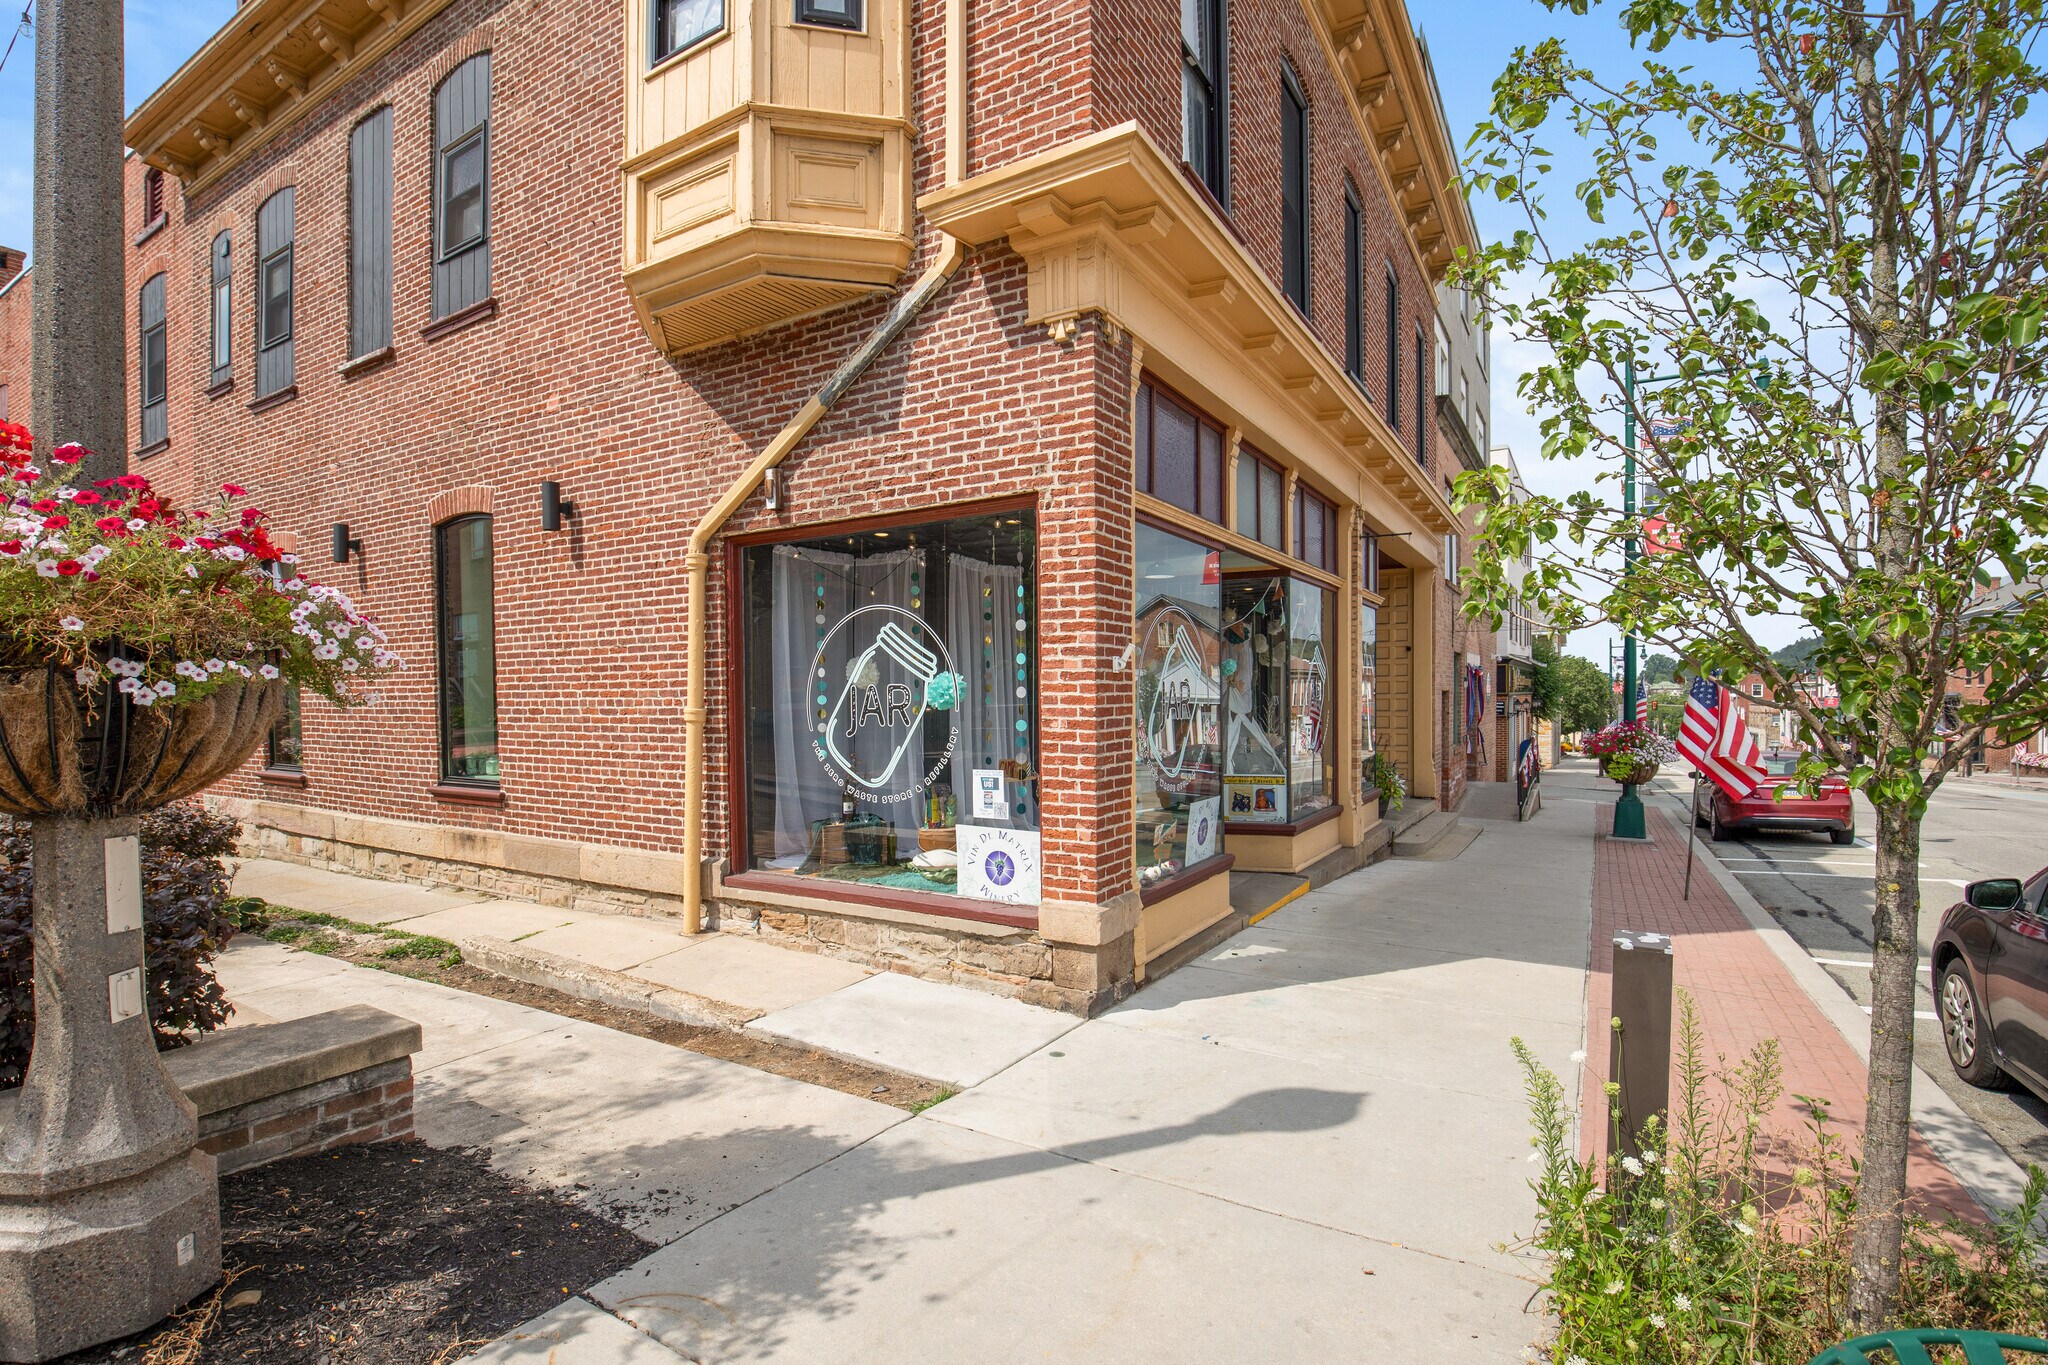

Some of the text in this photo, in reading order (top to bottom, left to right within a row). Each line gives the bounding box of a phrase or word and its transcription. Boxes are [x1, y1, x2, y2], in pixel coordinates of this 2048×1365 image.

[846, 684, 912, 738] JAR
[1159, 678, 1191, 731] JAR
[811, 726, 959, 804] THE ZERO WASTE STORE & REFILLERY
[967, 844, 980, 866] VIN
[998, 830, 1034, 873] MATRIX
